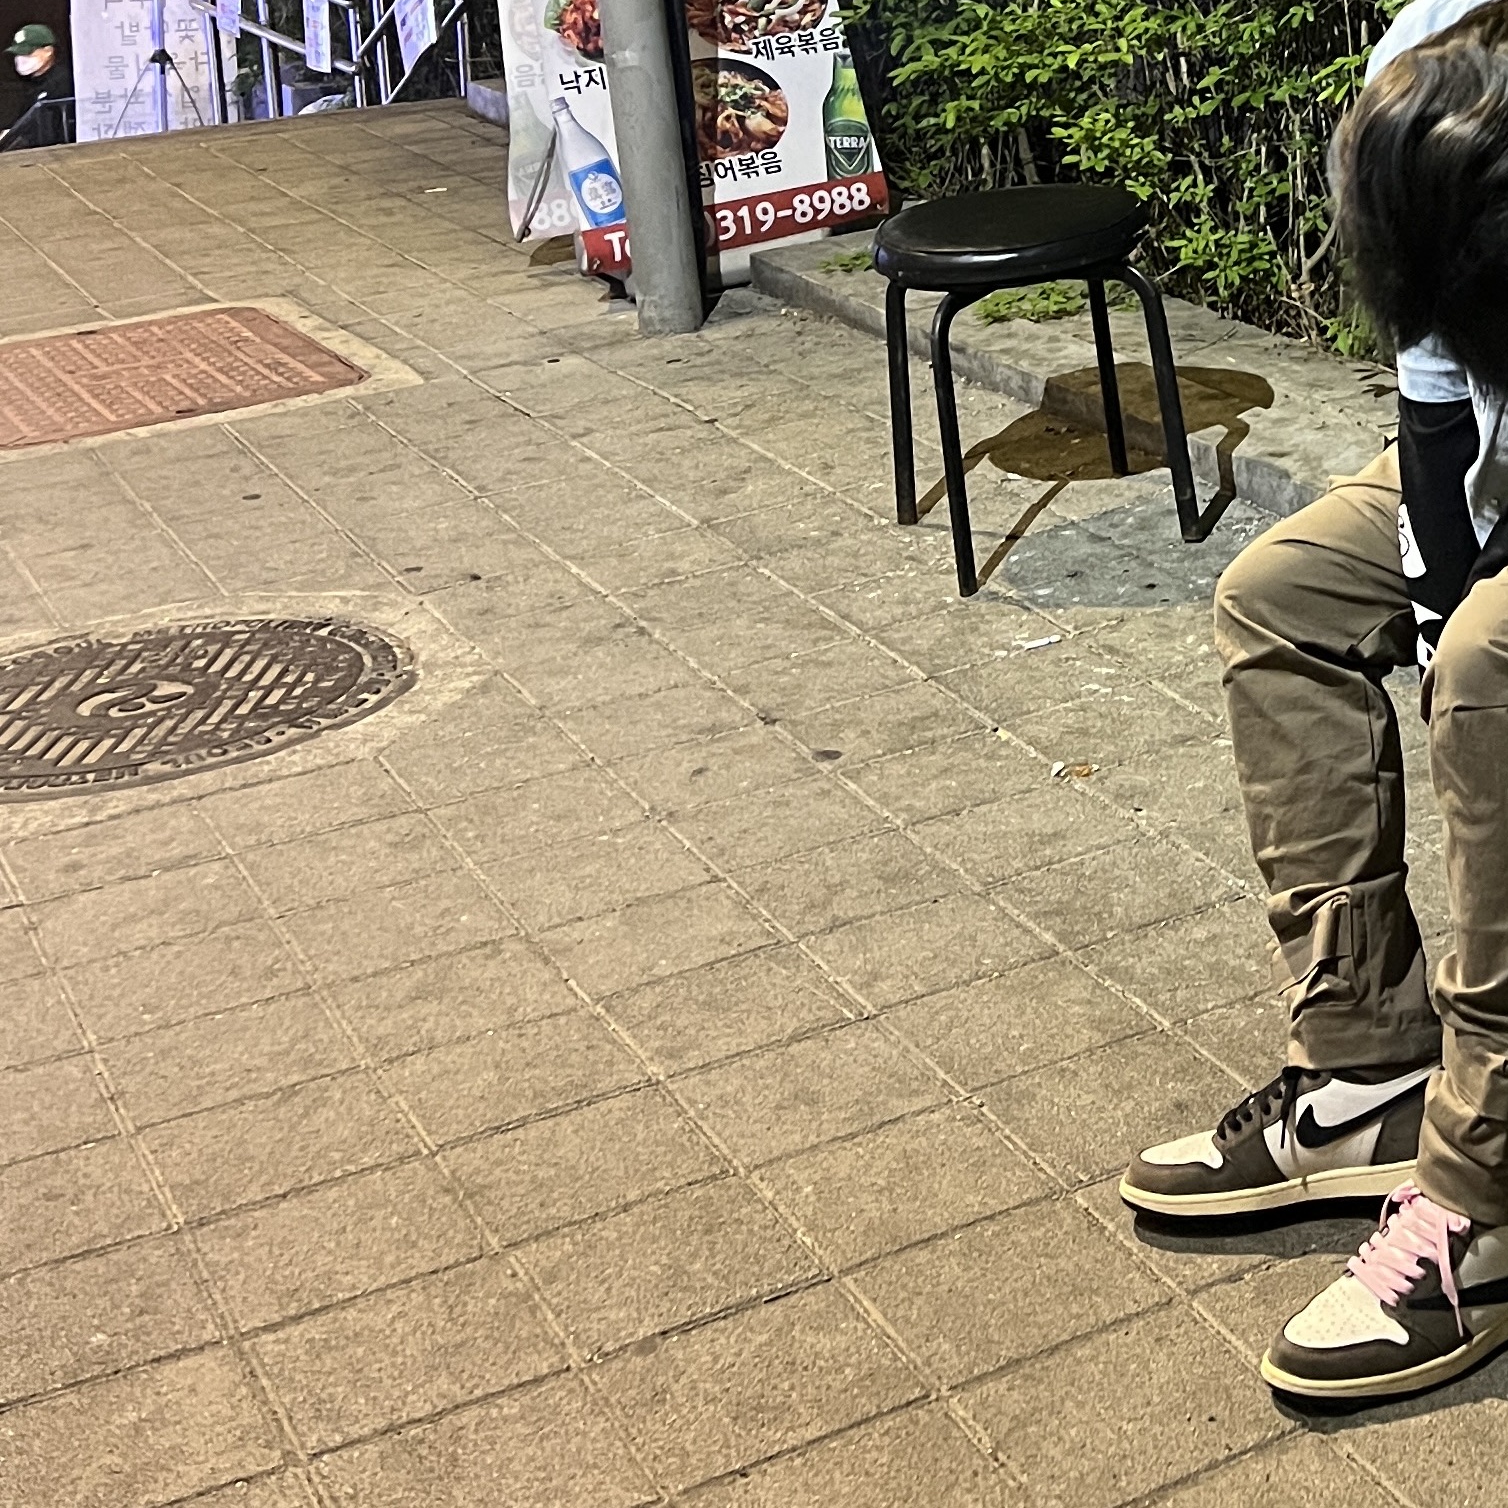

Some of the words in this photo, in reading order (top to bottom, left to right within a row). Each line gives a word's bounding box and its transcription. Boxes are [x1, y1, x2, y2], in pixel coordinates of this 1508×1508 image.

[752, 27, 840, 61] 제육볶음
[559, 67, 607, 94] 낙지
[829, 135, 868, 150] TERRA
